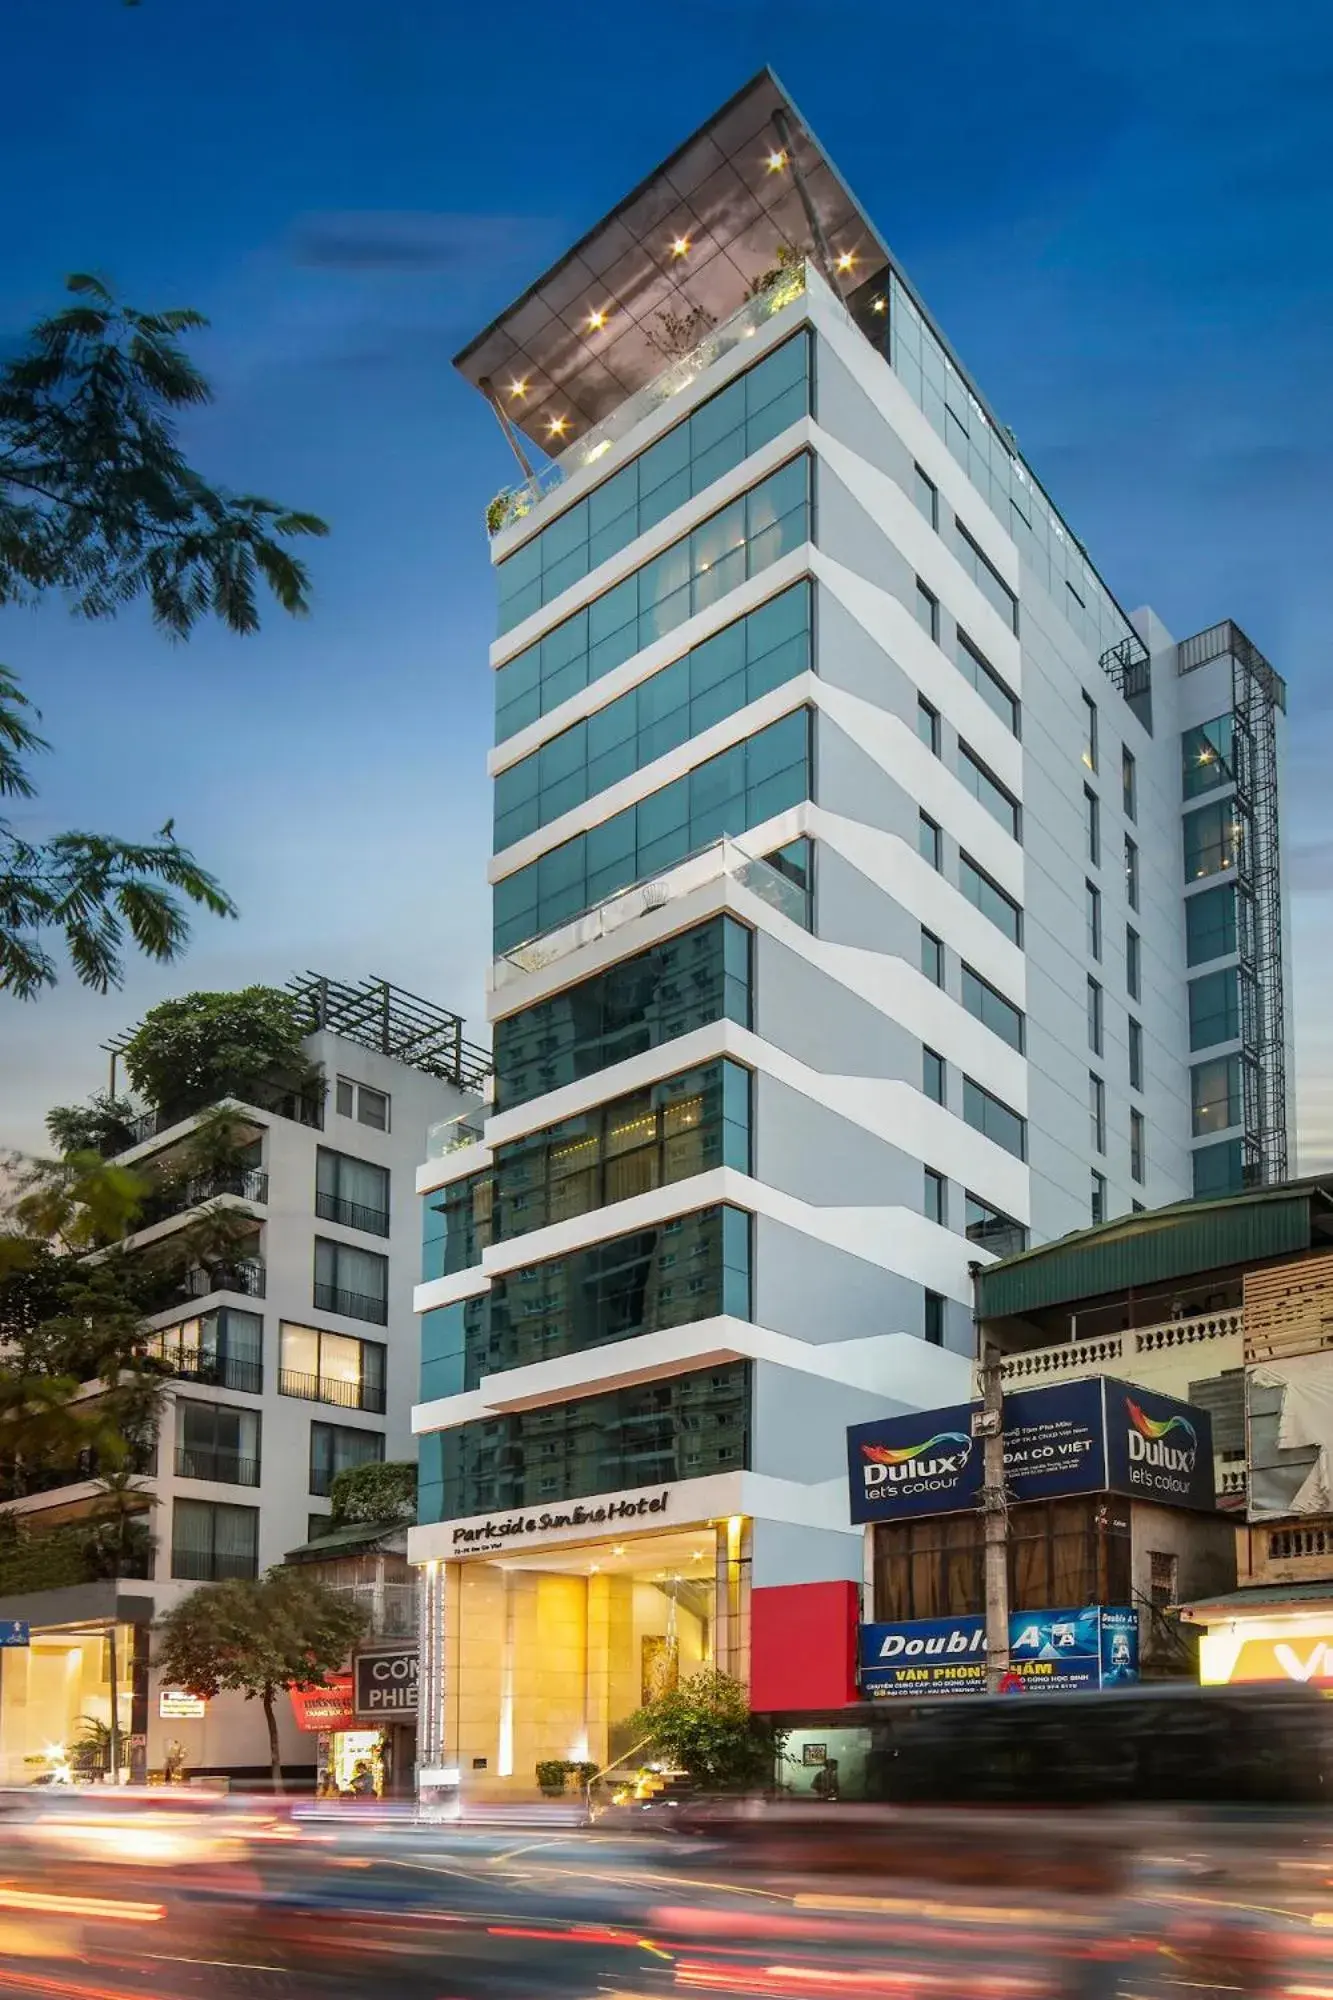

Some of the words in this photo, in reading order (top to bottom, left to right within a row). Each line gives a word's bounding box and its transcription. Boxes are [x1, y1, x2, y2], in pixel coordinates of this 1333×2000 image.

[1128, 1429, 1190, 1473] Dulux
[863, 1456, 958, 1485] Dulux
[1129, 1465, 1153, 1487] let's
[1155, 1474, 1191, 1494] colour
[864, 1486, 898, 1500] let's
[902, 1477, 960, 1495] colour
[452, 1516, 537, 1544] Parkside
[607, 1490, 669, 1520] Hotel
[1011, 1625, 1040, 1649] A
